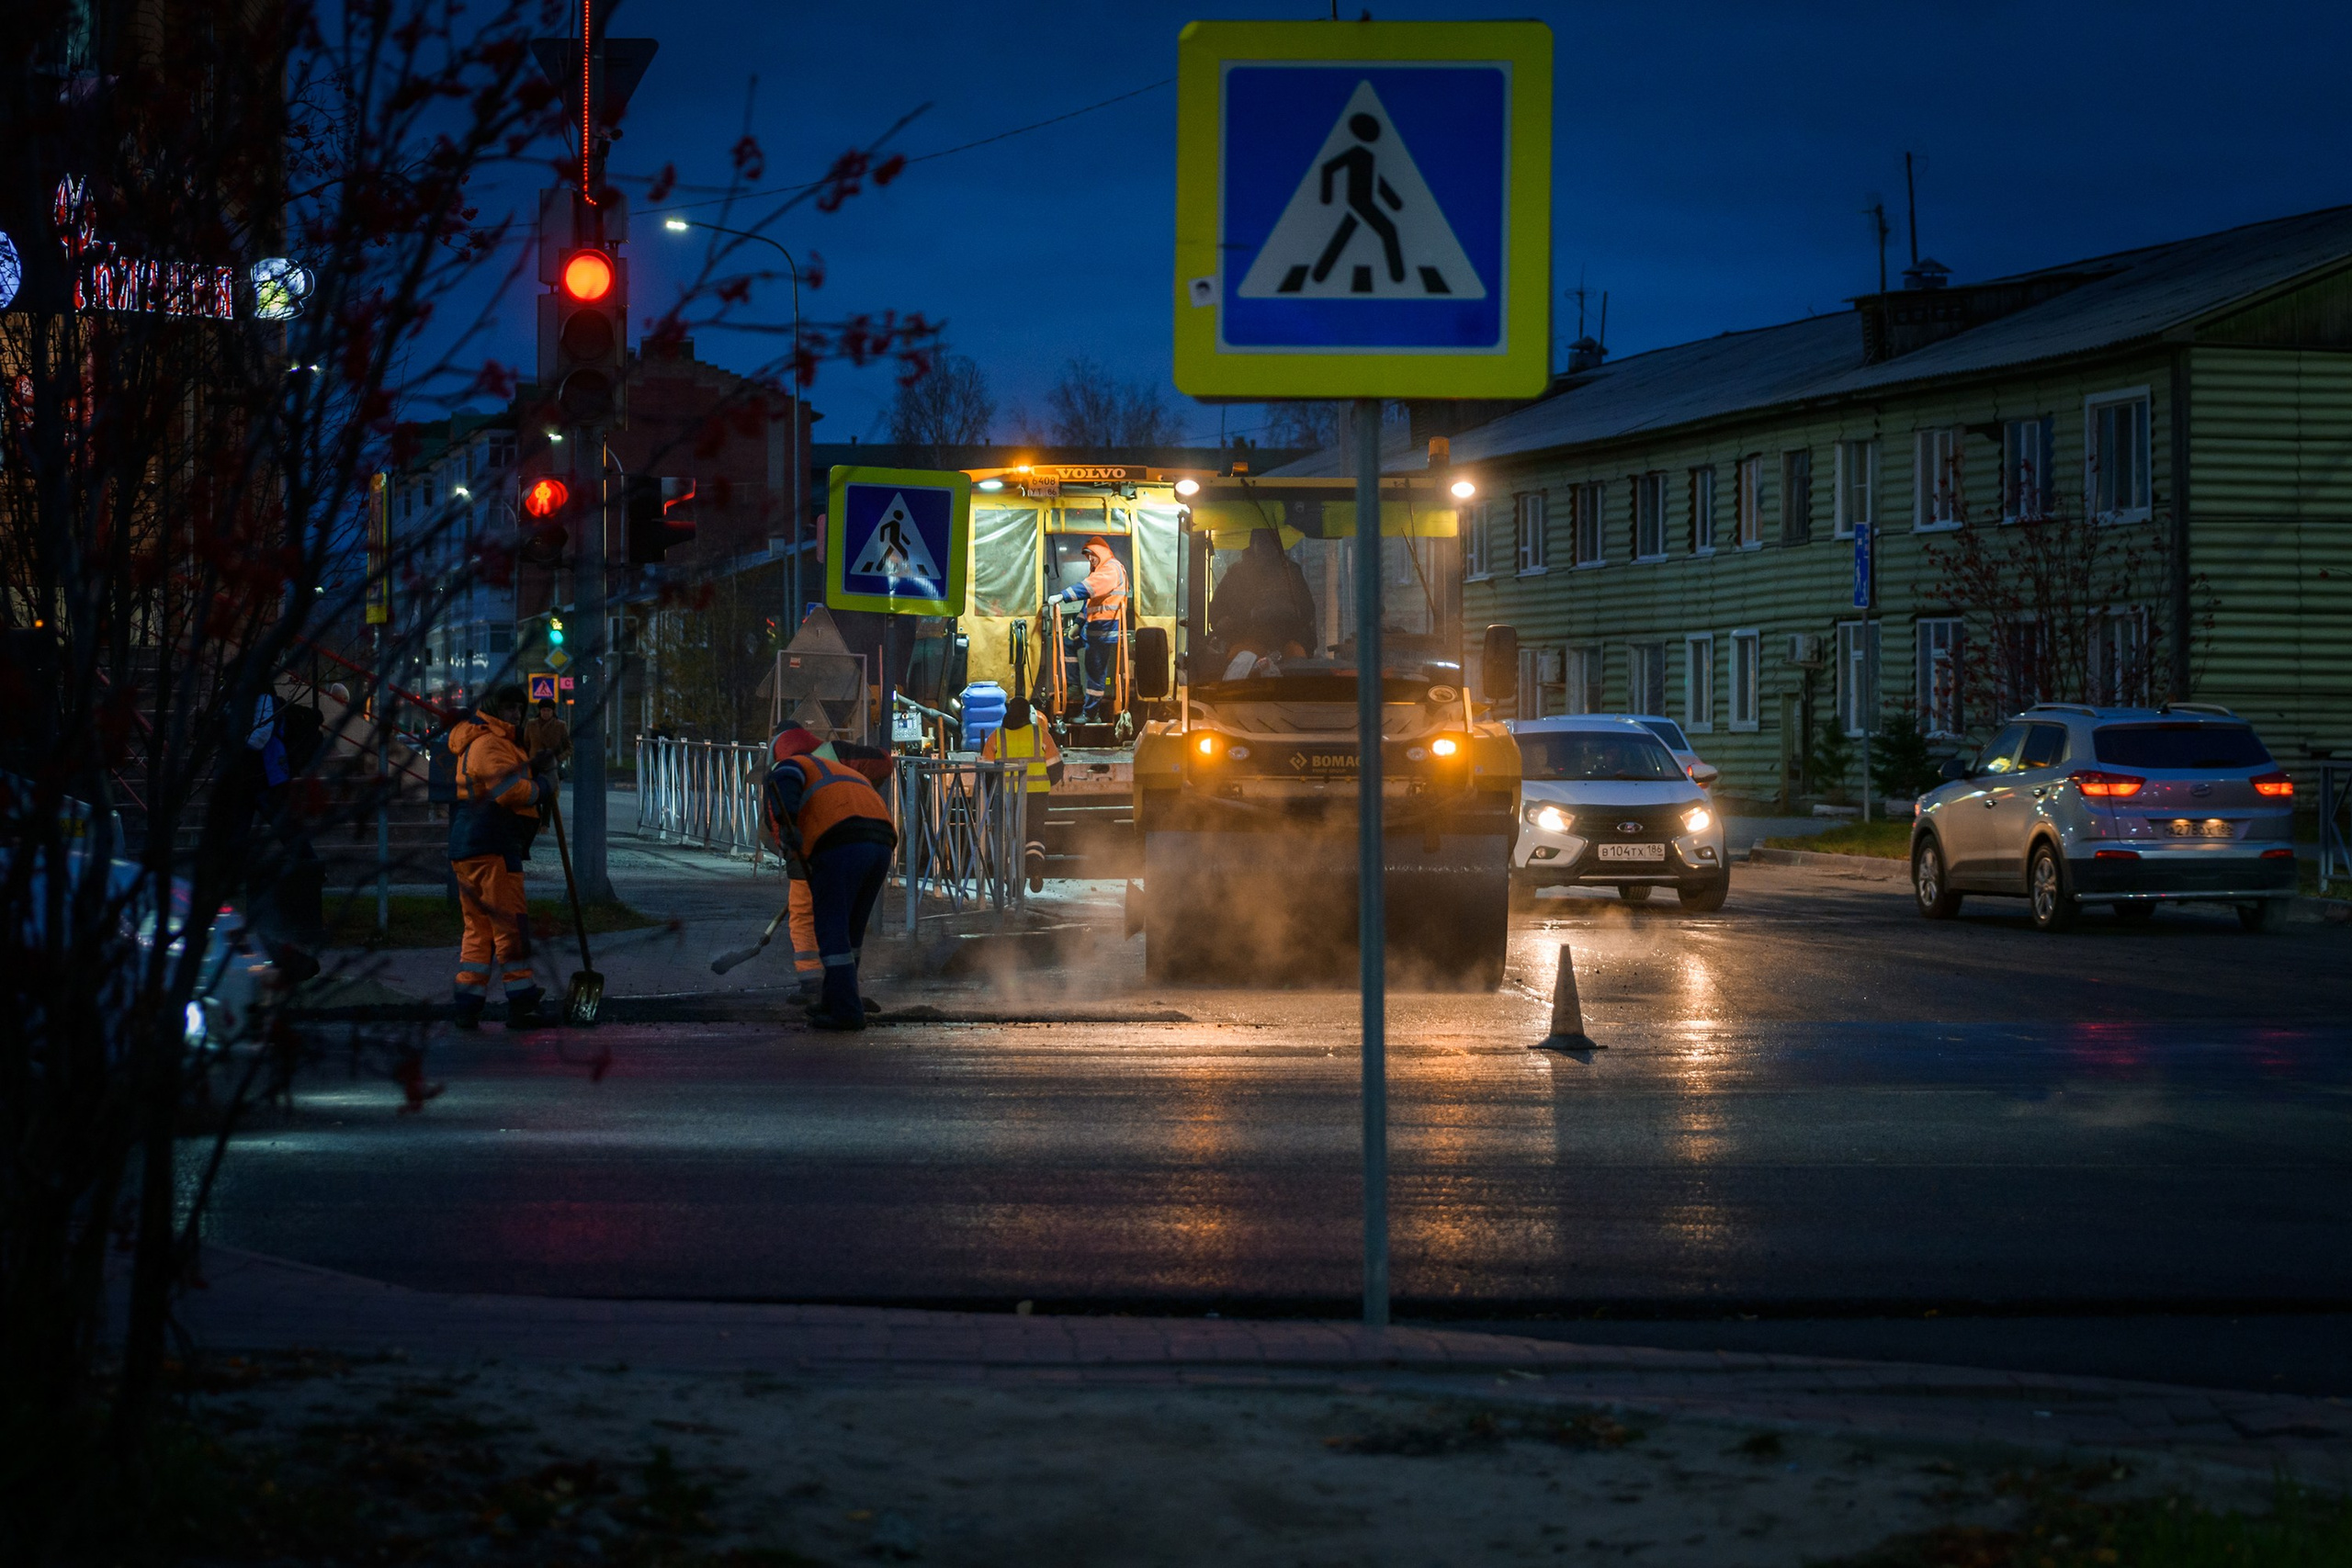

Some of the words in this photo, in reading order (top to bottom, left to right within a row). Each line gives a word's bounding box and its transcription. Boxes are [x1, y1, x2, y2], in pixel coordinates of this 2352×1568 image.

[1056, 468, 1126, 479] VOLVO
[1032, 477, 1056, 486] 6408
[1646, 844, 1662, 854] 186
